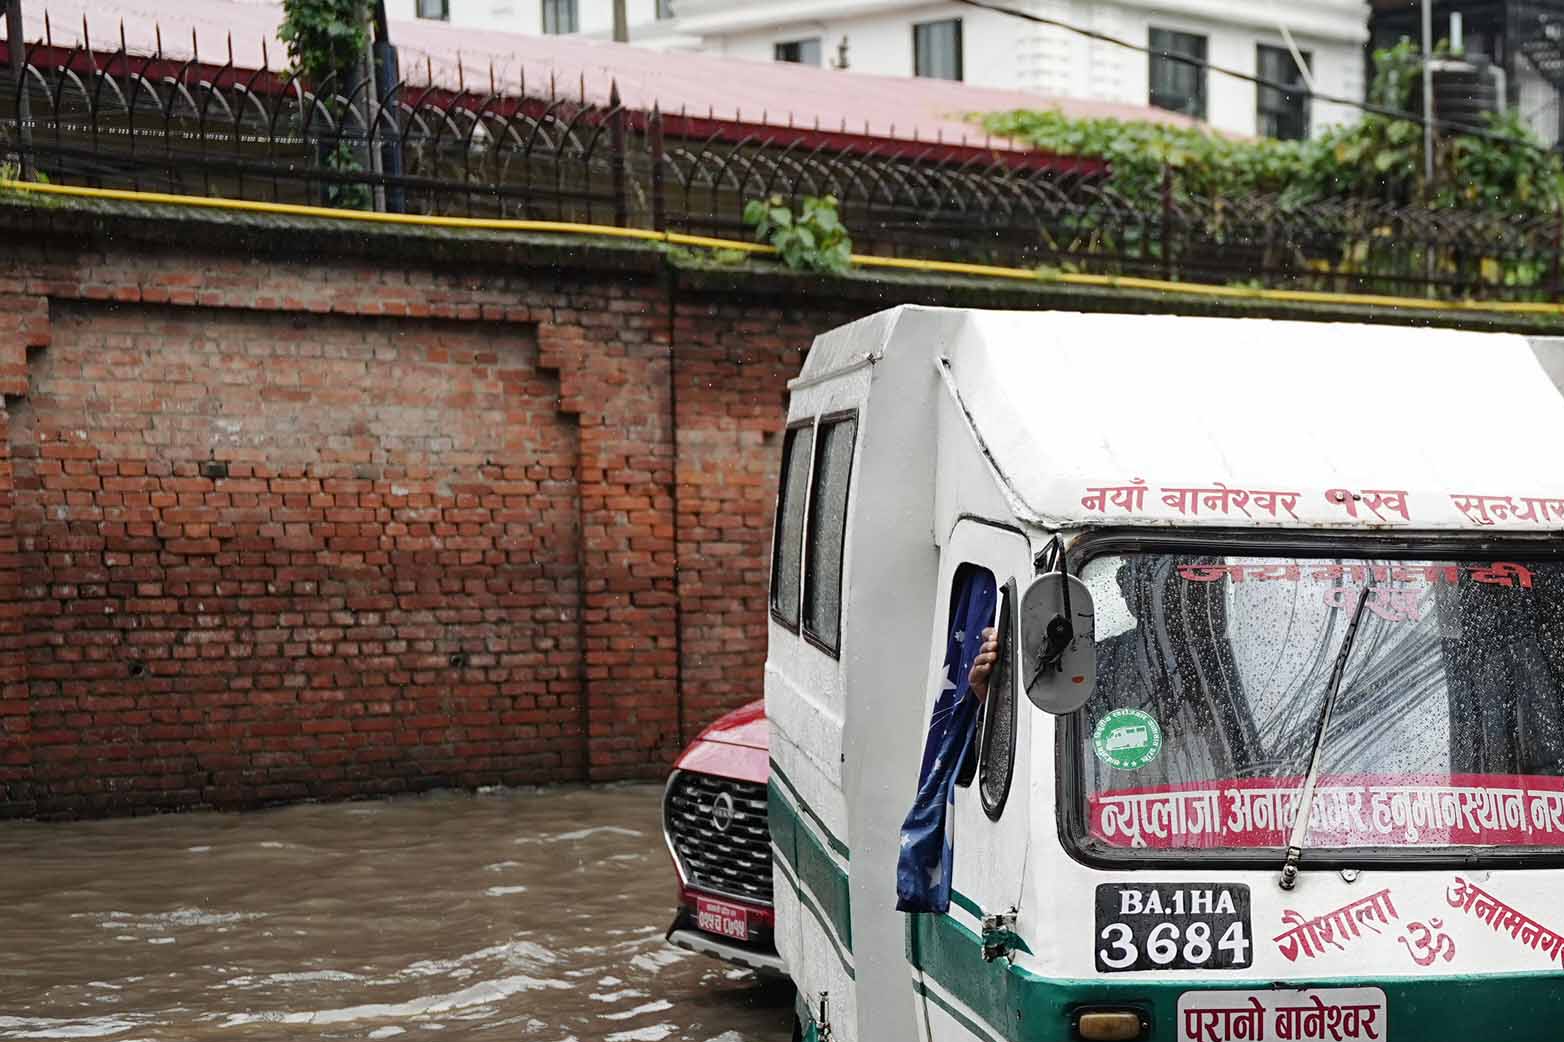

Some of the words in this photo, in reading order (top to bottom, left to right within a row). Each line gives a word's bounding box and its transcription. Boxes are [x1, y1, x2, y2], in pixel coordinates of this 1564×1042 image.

[1081, 477, 1148, 513] नयाँ
[1160, 482, 1300, 521] बानेश्वर
[1100, 921, 1249, 969] 3684
[1275, 995, 1381, 1042] बानेश्वर
